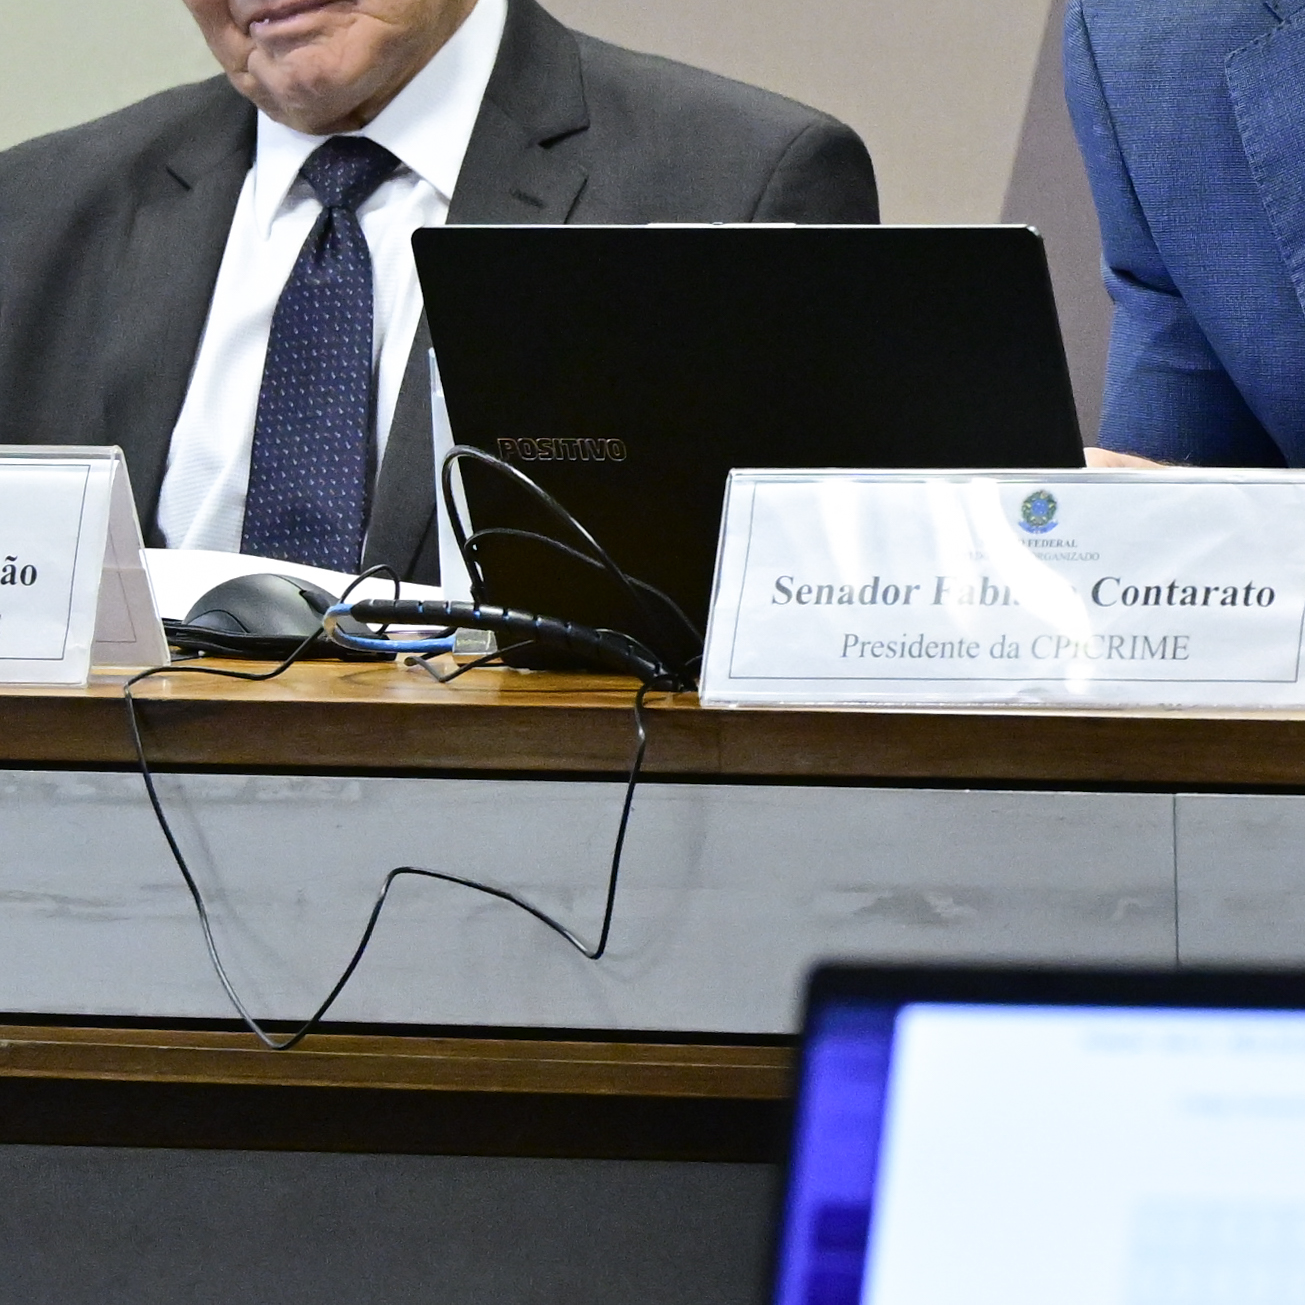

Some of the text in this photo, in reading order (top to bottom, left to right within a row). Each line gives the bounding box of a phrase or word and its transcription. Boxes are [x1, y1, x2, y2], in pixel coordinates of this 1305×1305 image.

[497, 437, 627, 462] POSITIVO
[1028, 539, 1077, 548] FEDERAL
[1034, 552, 1099, 562] RGANIZADO
[771, 575, 1276, 608] Senador Fabi Contarato
[841, 633, 1190, 661] Presidente da CPICRIME
